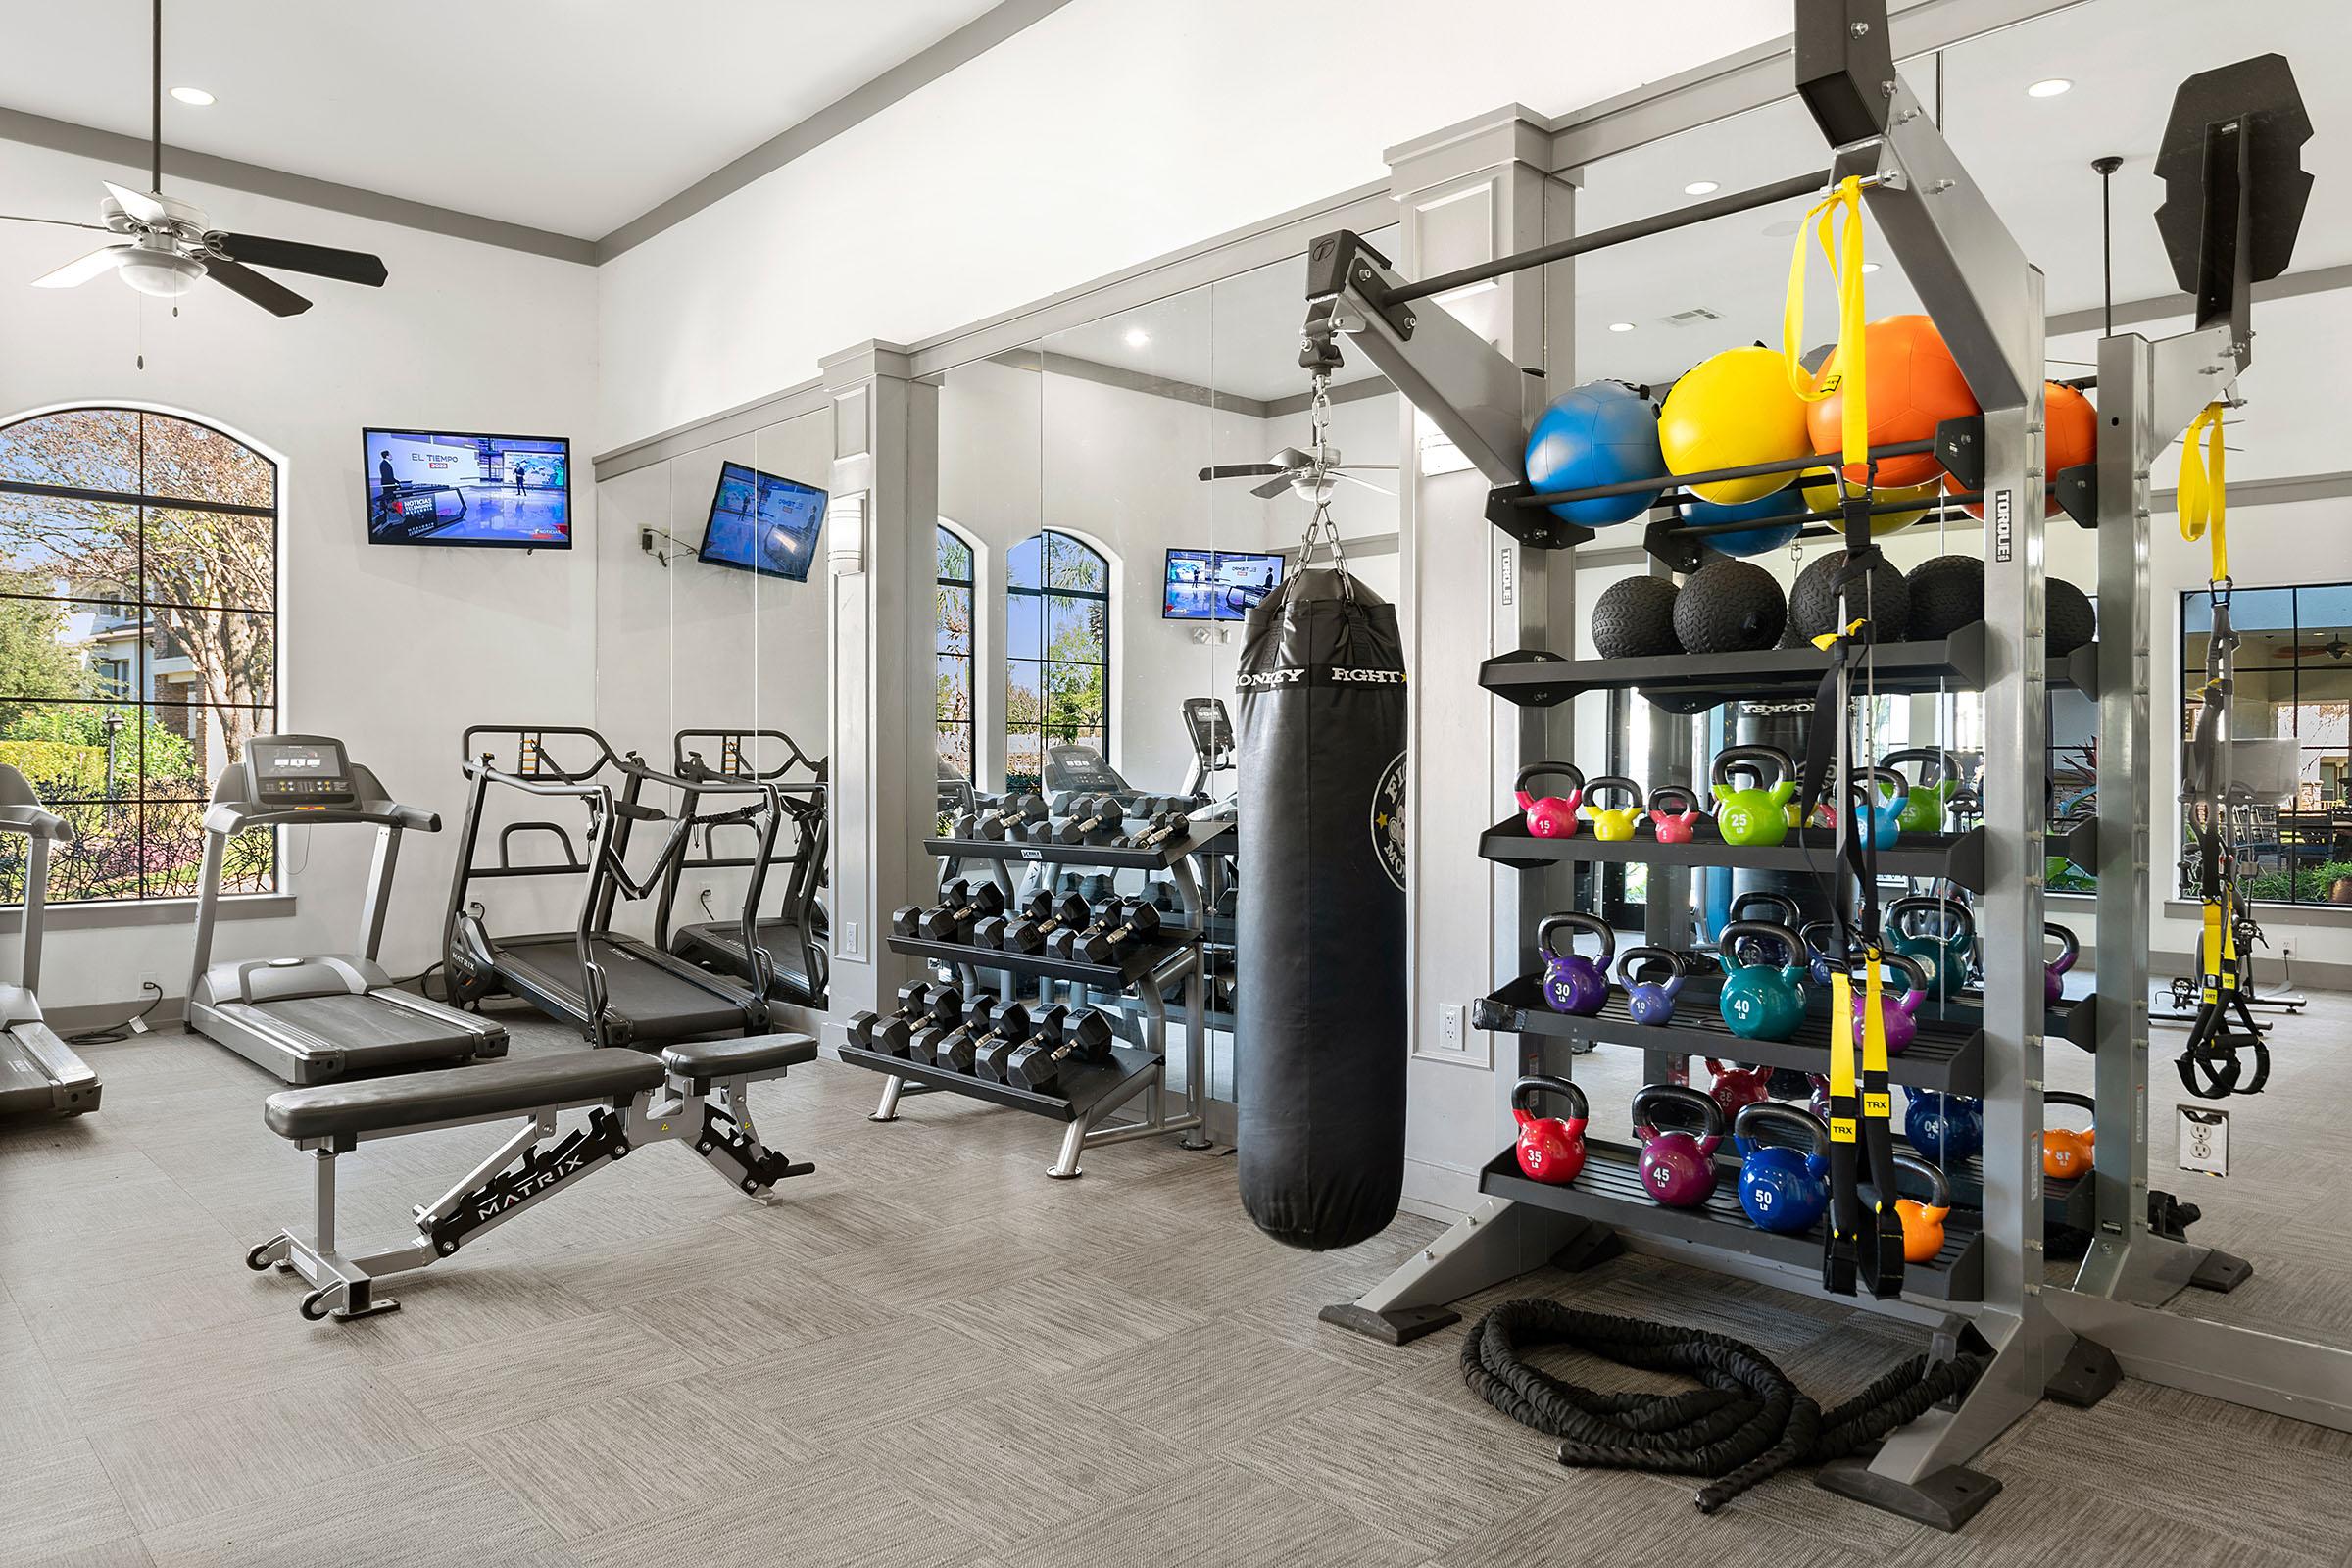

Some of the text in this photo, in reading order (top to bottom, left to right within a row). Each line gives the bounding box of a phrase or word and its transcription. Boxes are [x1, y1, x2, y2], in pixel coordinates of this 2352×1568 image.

[412, 453, 459, 463] EL TIEMPO
[404, 498, 432, 508] NOTICIAS
[1997, 491, 2010, 555] TORQUE
[1502, 549, 1511, 599] TORQUE
[1331, 667, 1400, 683] FIGHT
[1538, 820, 1550, 830] 15
[1731, 814, 1747, 827] 25
[452, 952, 475, 971] MATRIX
[1555, 983, 1570, 997] 30
[1636, 1002, 1646, 1010] 10
[1734, 999, 1749, 1013] 40
[1866, 1101, 1886, 1109] TRX
[1833, 1126, 1853, 1135] TRX
[1528, 1150, 1541, 1163] 35
[1653, 1167, 1669, 1182] 45
[477, 1154, 584, 1221] MATRIX
[1755, 1189, 1772, 1204] 50
